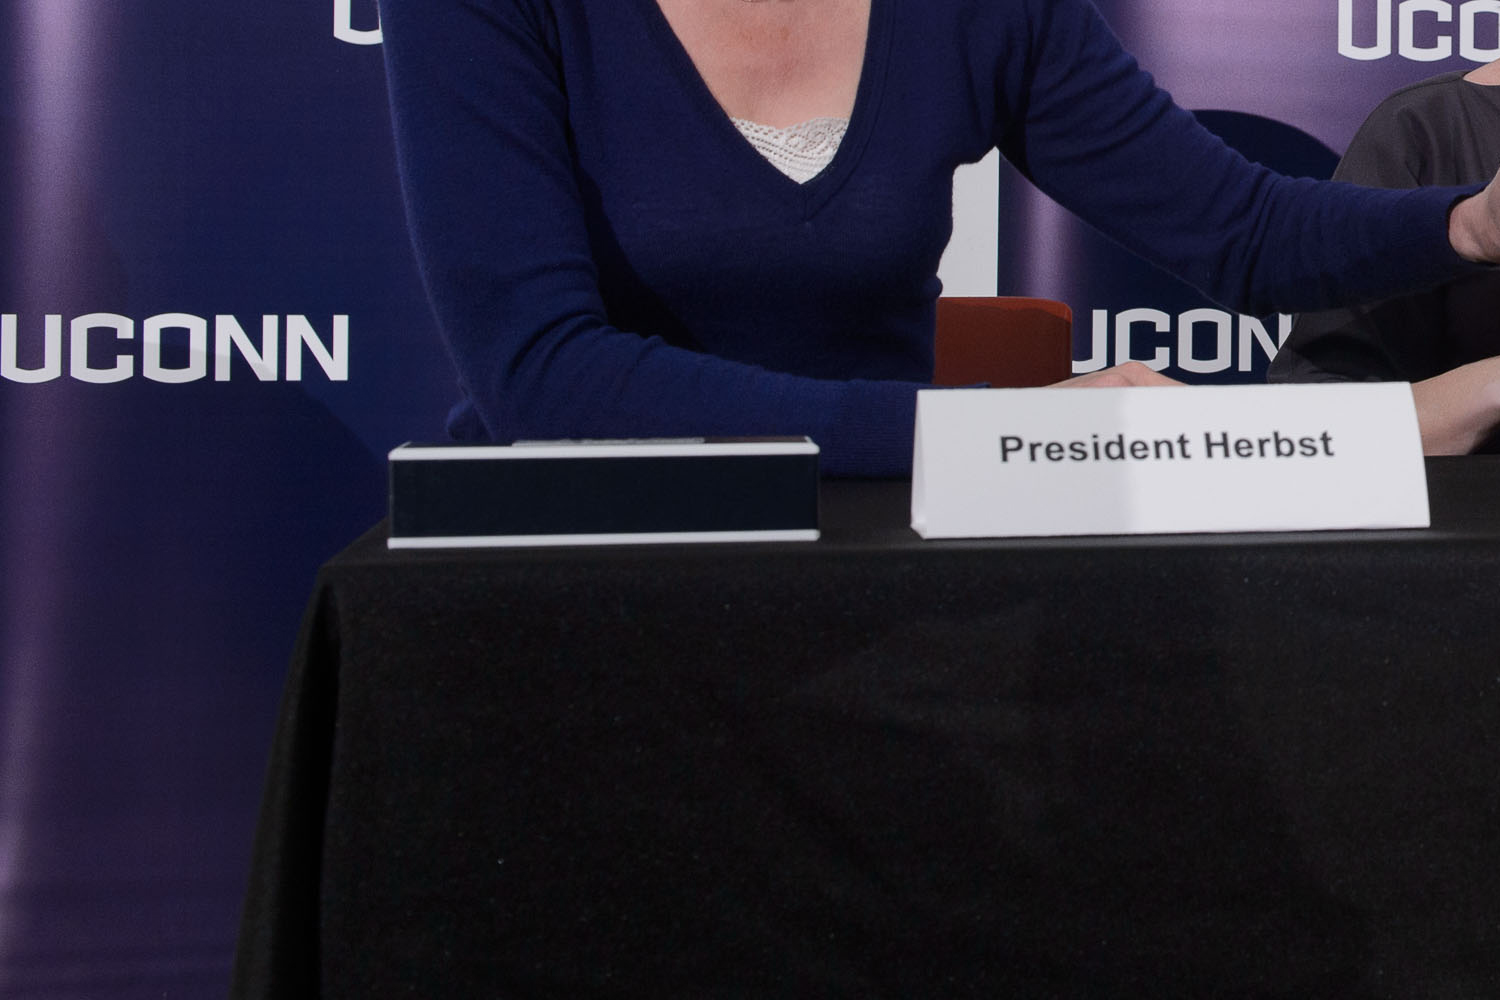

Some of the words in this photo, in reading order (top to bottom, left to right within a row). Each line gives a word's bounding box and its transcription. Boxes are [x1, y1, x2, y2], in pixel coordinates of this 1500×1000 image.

[0, 312, 349, 384] UCONN
[1072, 308, 1293, 374] UCON
[999, 432, 1193, 464] President
[1203, 429, 1336, 460] Herbst
